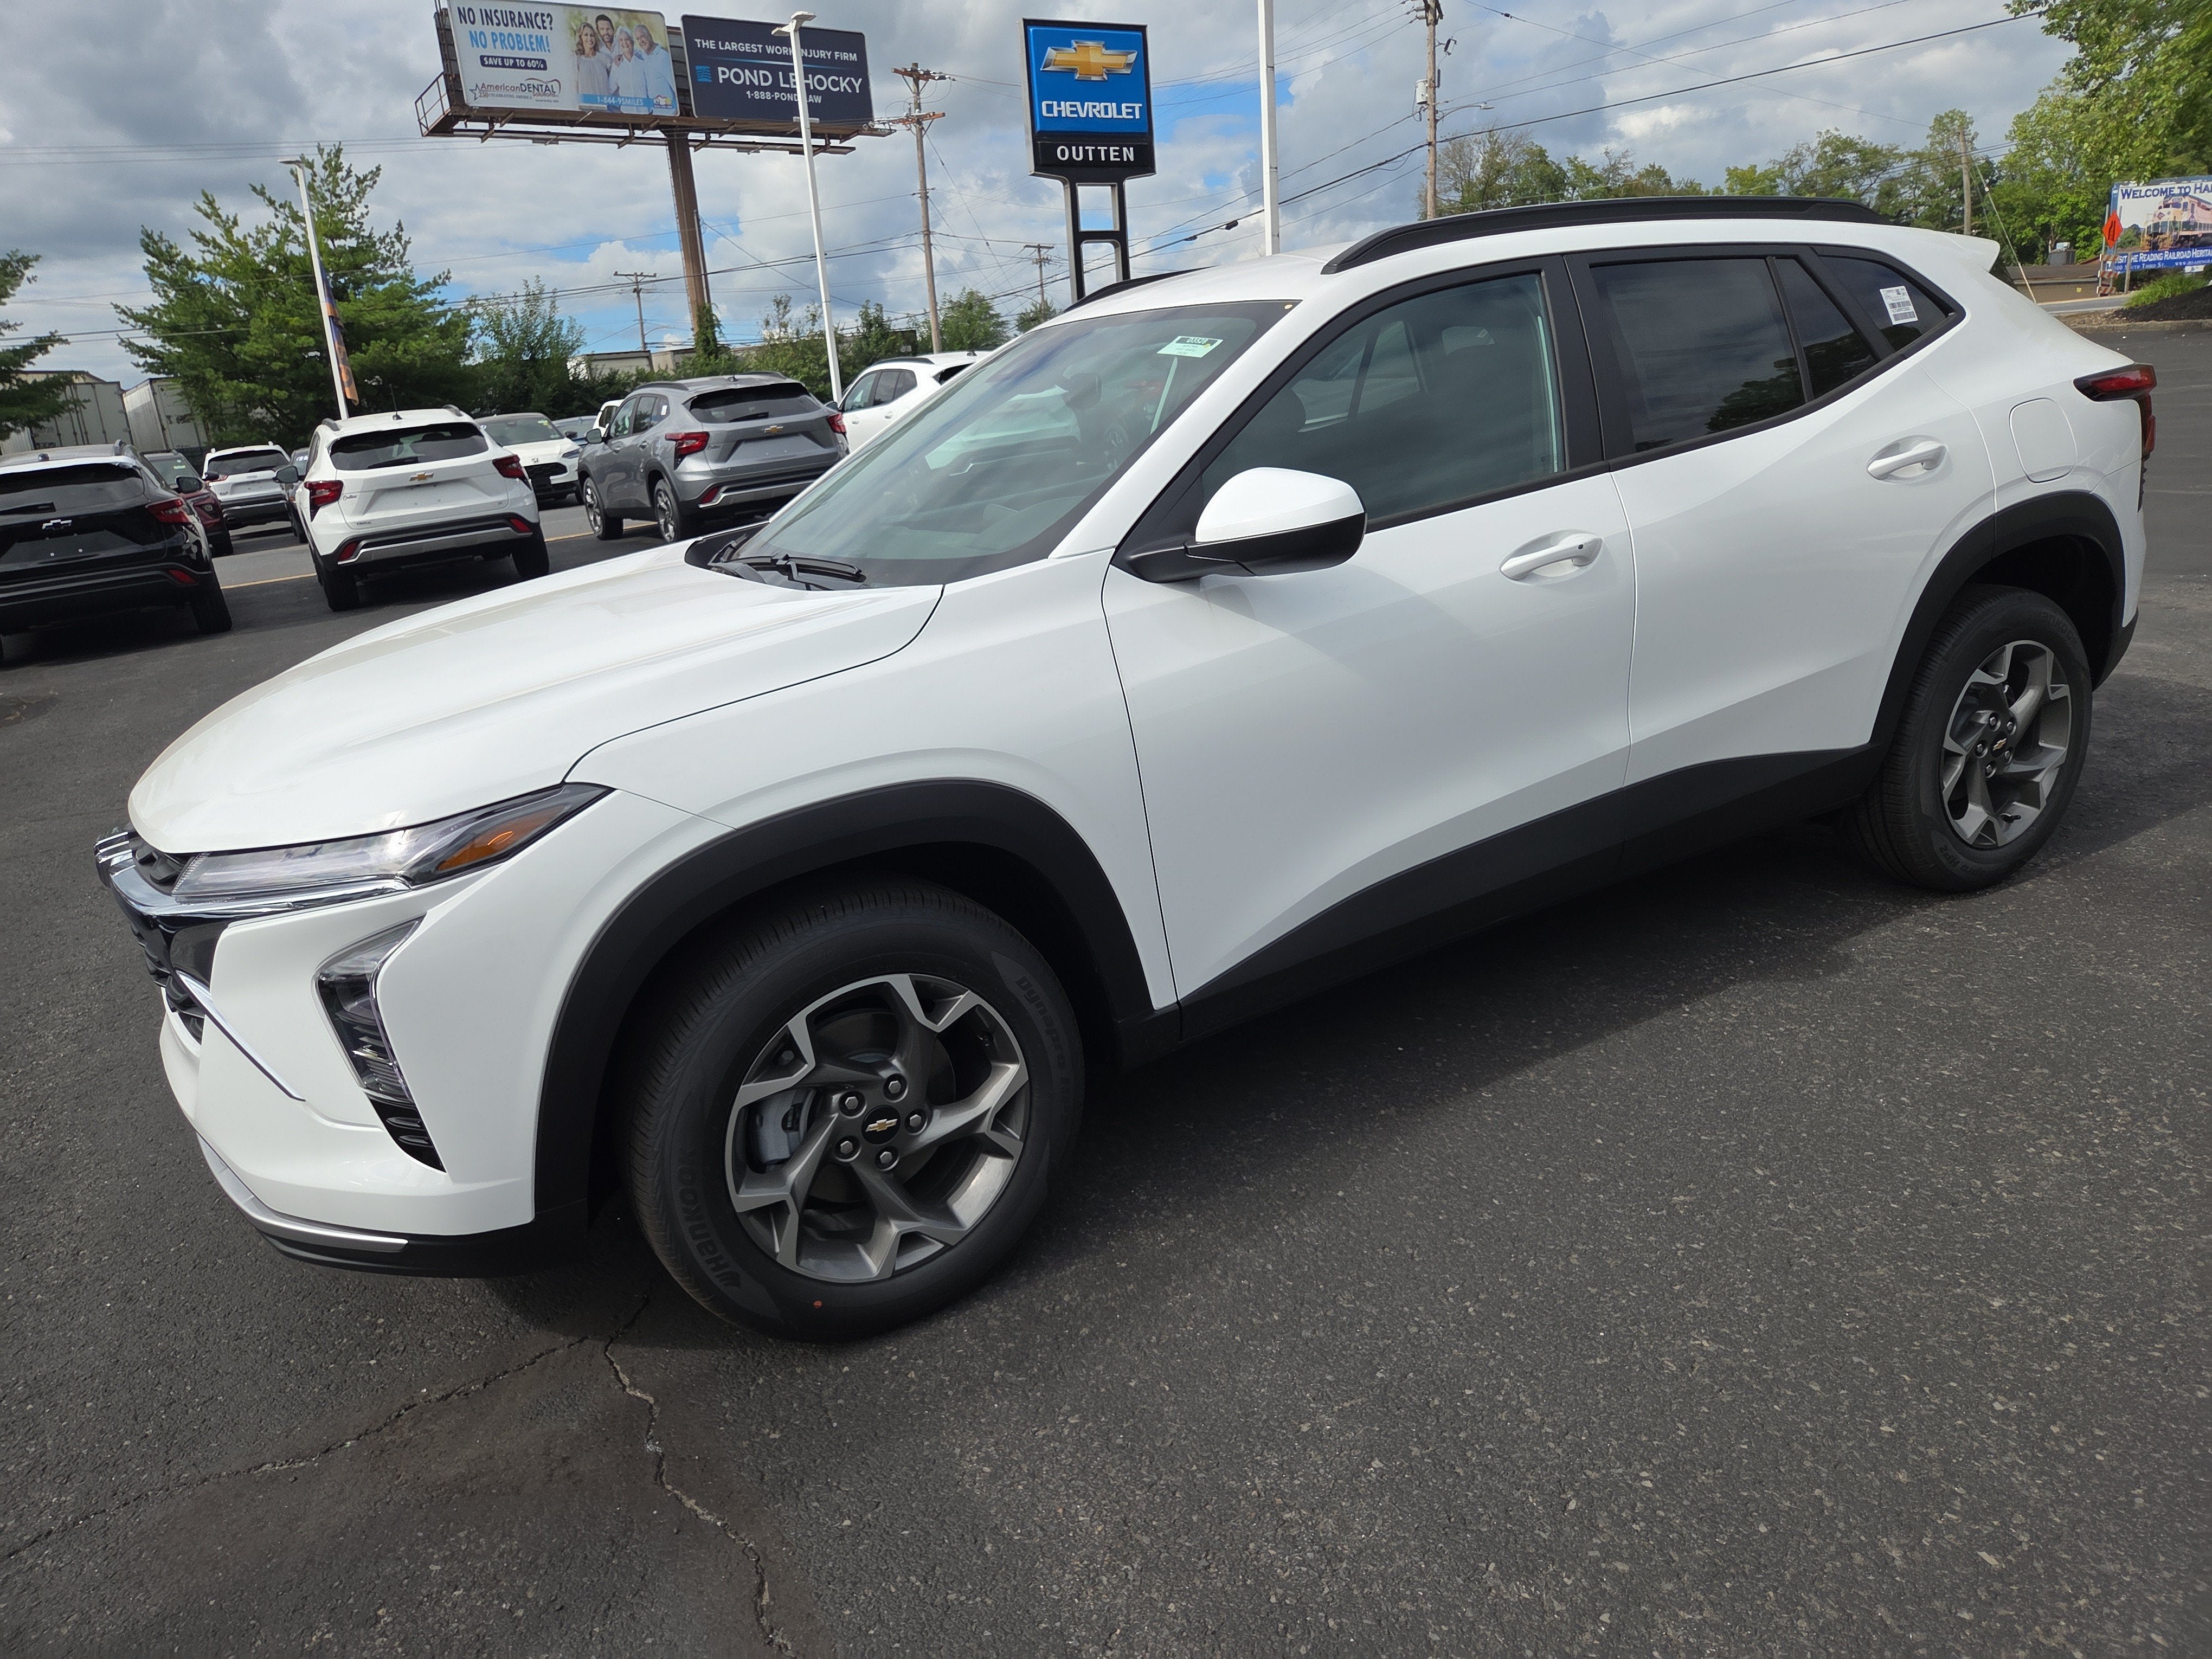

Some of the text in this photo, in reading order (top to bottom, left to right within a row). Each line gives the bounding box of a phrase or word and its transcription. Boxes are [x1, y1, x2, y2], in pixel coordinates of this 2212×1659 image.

[458, 7, 553, 30] NO INSURANCE?
[469, 30, 551, 53] NO PROBLEM!
[694, 38, 716, 49] THE
[718, 41, 763, 53] LARGEST
[800, 48, 832, 60] NJURY
[834, 52, 857, 61] FIRM
[484, 57, 544, 68] SAVE UP TO 60%
[717, 67, 863, 93] POND LEHOCKY
[746, 91, 822, 104] 1-888-PONDAW
[1041, 101, 1142, 119] CHEVROLET
[1057, 145, 1134, 162] OUTTEN
[2121, 187, 2175, 200] WELCOME
[2177, 185, 2191, 196] TO
[2131, 254, 2139, 263] HE
[2139, 253, 2163, 262] READING
[2164, 250, 2191, 260] RAILROAD
[2192, 248, 2212, 258] HERITA
